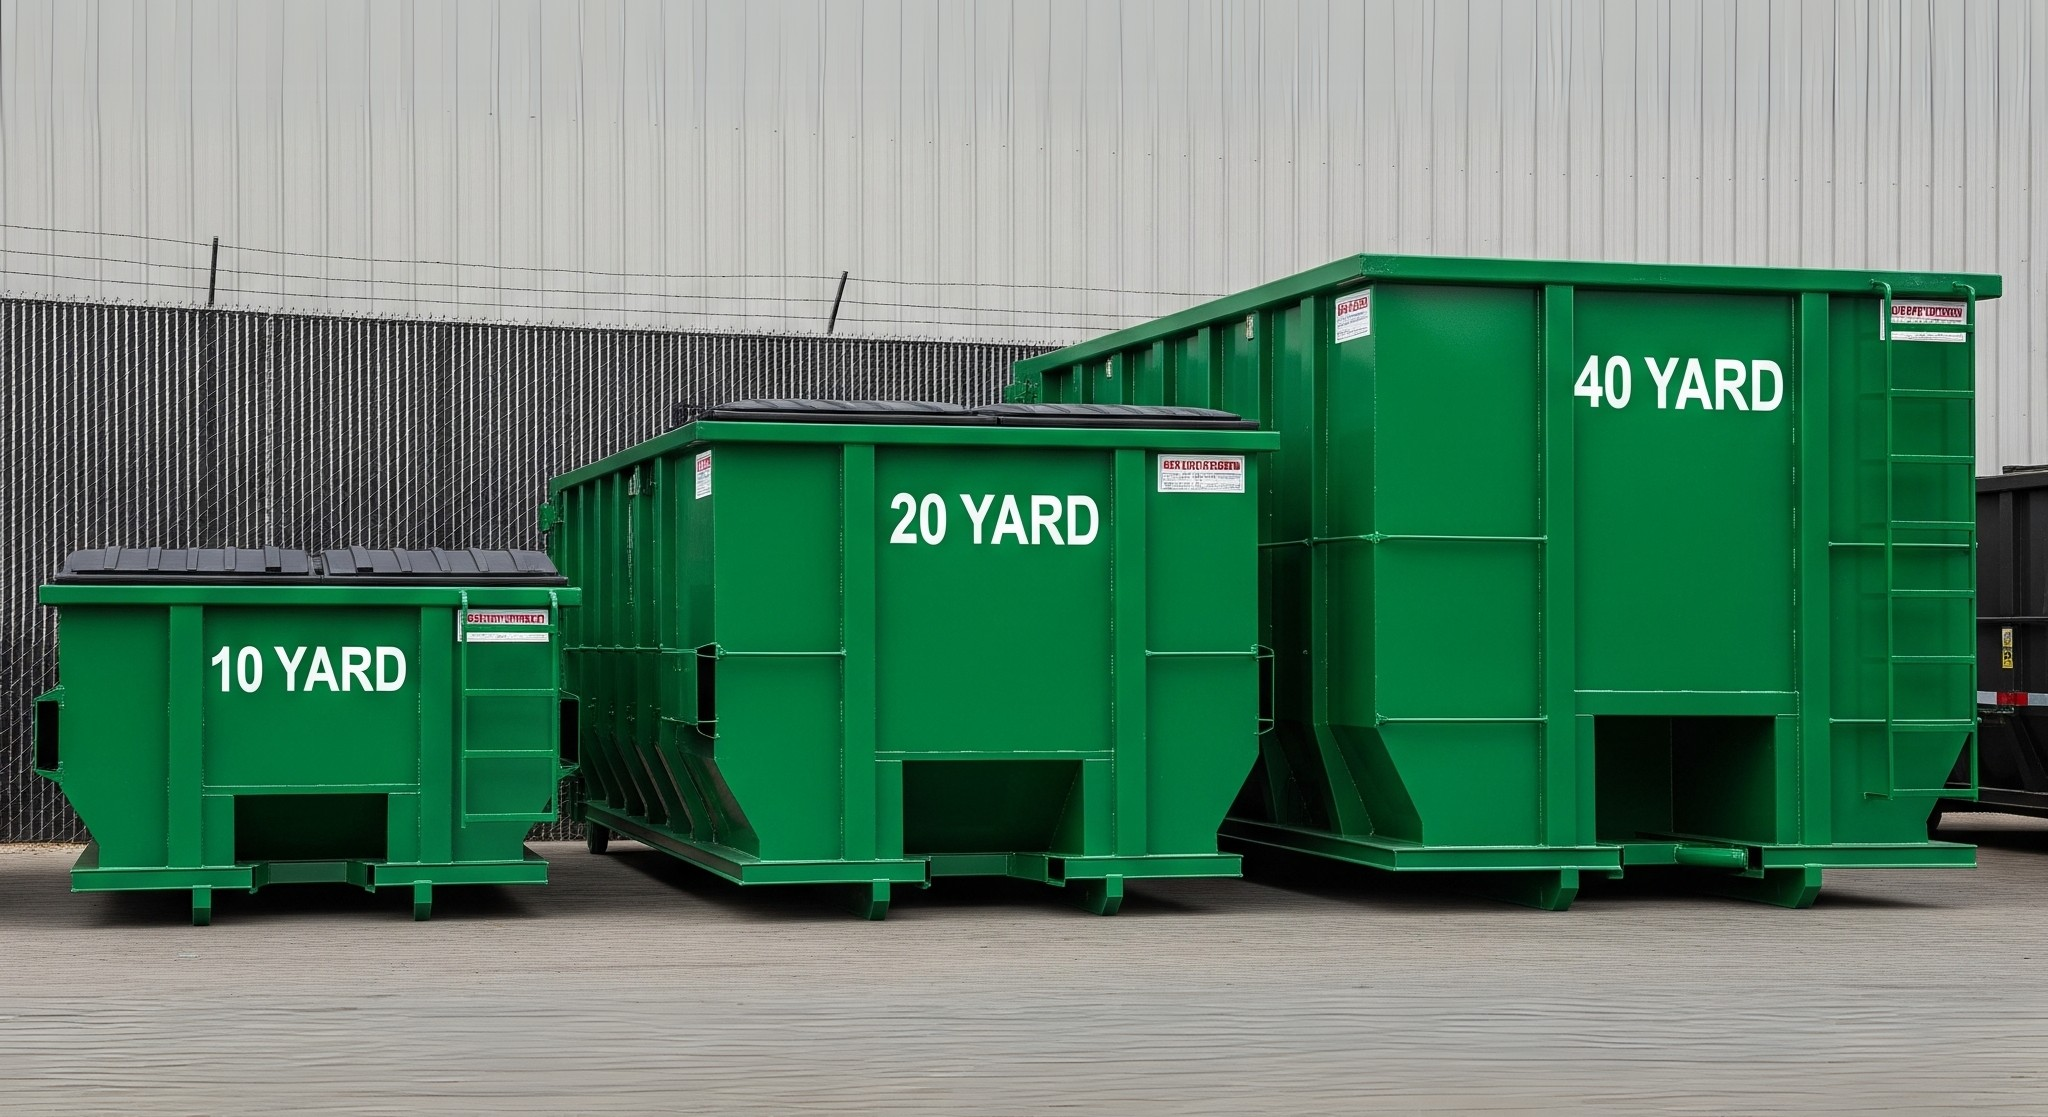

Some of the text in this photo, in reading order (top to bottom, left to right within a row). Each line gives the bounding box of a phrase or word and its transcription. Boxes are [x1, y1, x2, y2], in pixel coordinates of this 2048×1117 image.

[1573, 354, 1784, 412] 40 YARD
[889, 492, 1100, 546] 20 YARD
[211, 645, 407, 693] 10 YARD
